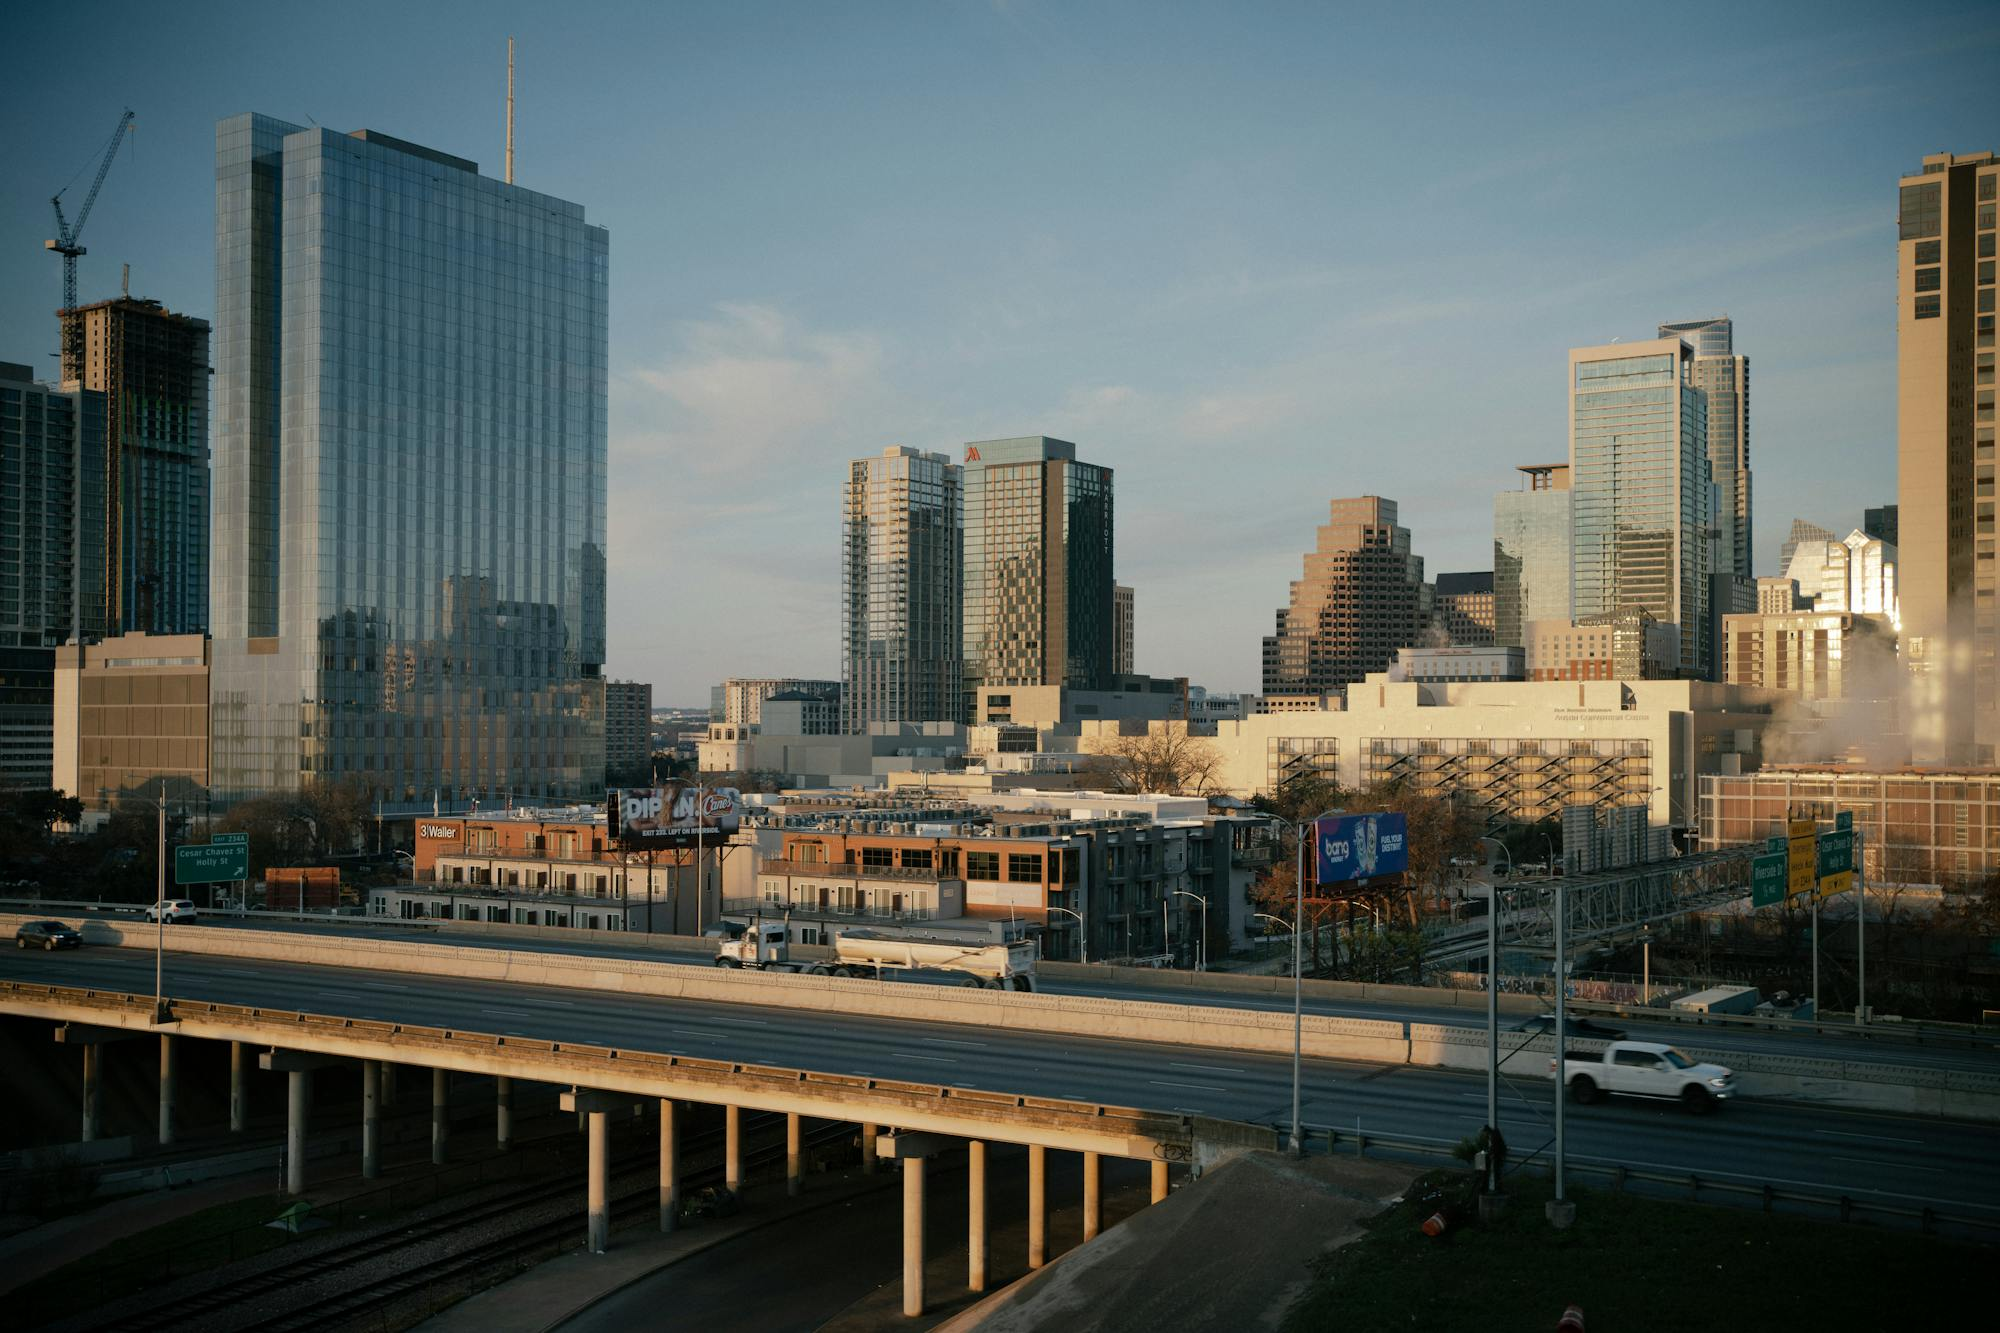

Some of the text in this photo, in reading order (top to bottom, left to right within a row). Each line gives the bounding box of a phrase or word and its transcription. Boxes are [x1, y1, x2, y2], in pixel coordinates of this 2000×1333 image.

[627, 798, 662, 819] DIP
[1381, 833, 1402, 844] FUEL YOUR
[236, 847, 244, 855] St
[1325, 837, 1349, 859] bang
[196, 858, 217, 867] Holly
[1755, 864, 1777, 880] Riverside
